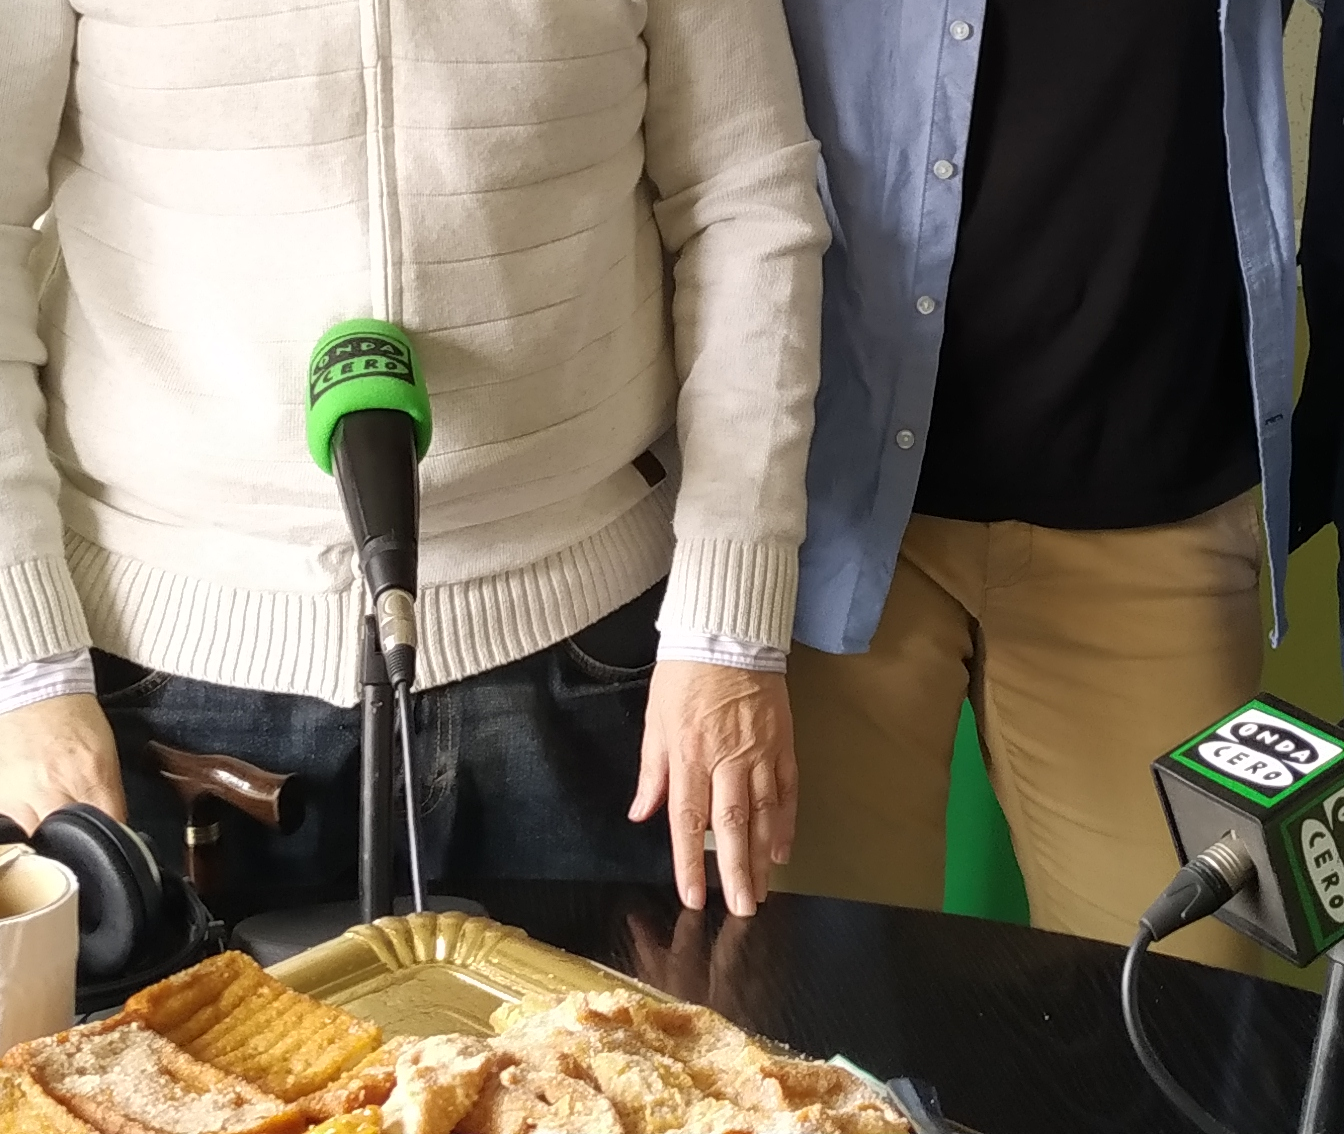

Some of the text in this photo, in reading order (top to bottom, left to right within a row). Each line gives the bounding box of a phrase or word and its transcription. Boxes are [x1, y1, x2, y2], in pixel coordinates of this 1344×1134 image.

[318, 342, 395, 368] ONDA
[322, 359, 397, 383] CERO
[1238, 723, 1311, 763] ONDA
[1213, 746, 1282, 781] CERO
[1309, 831, 1344, 909] CERO
